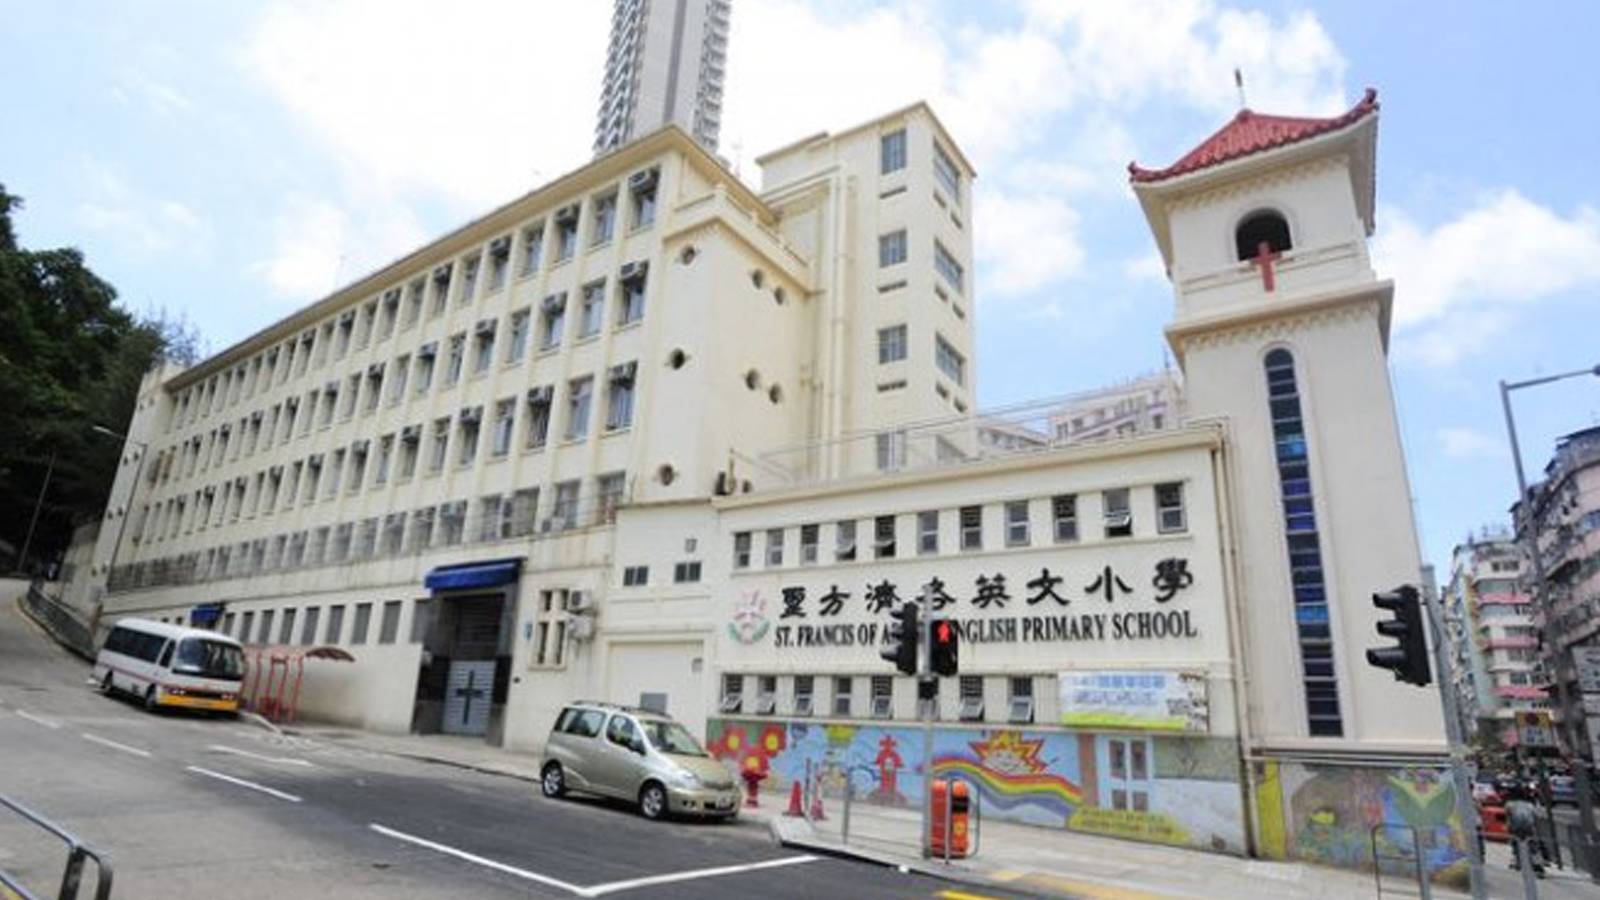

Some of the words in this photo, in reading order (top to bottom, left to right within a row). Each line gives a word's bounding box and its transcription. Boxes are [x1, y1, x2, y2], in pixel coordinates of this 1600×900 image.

[774, 625, 795, 648] ST.
[797, 623, 854, 648] FRANCIS
[857, 622, 878, 645] OF
[954, 619, 1018, 643] NGLISH
[1022, 614, 1107, 643] PRIMARY
[1111, 609, 1198, 640] SCHOOL
